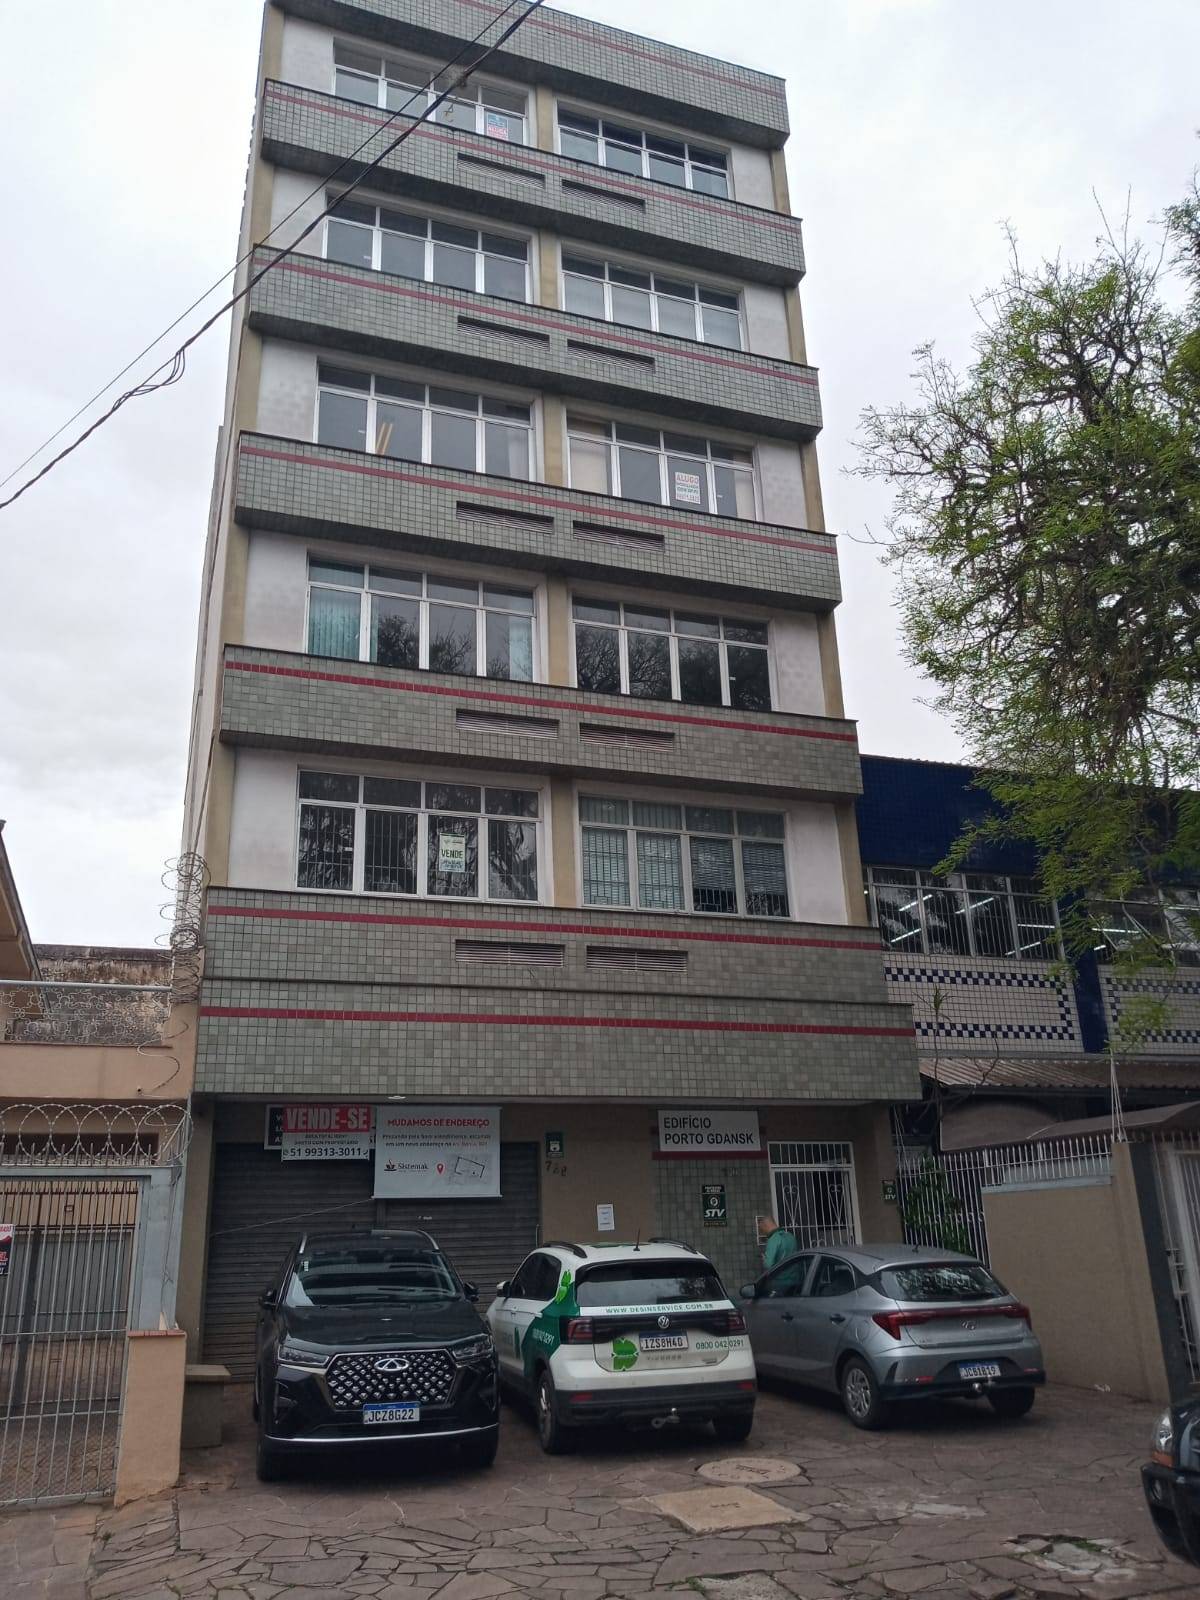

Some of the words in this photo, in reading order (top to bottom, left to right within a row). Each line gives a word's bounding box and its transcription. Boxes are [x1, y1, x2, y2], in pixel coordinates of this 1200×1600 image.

[677, 474, 698, 484] ALUGO
[441, 849, 463, 859] VENDE
[286, 1107, 368, 1130] VENDE-SE
[388, 1118, 432, 1127] MUDAMOS
[434, 1118, 444, 1127] DE
[446, 1118, 490, 1128] ENDEREÇO
[663, 1115, 711, 1128] EDIFÍCIO
[665, 1133, 703, 1144] PORTO
[707, 1133, 754, 1144] GDANSK
[290, 1147, 301, 1157] 51
[305, 1147, 361, 1157] 99313-3011
[704, 1208, 725, 1217] STV
[695, 1341, 713, 1350] 0800
[714, 1340, 728, 1349] 042
[729, 1339, 744, 1348] 0291
[368, 1409, 414, 1422] JCZ8G22
